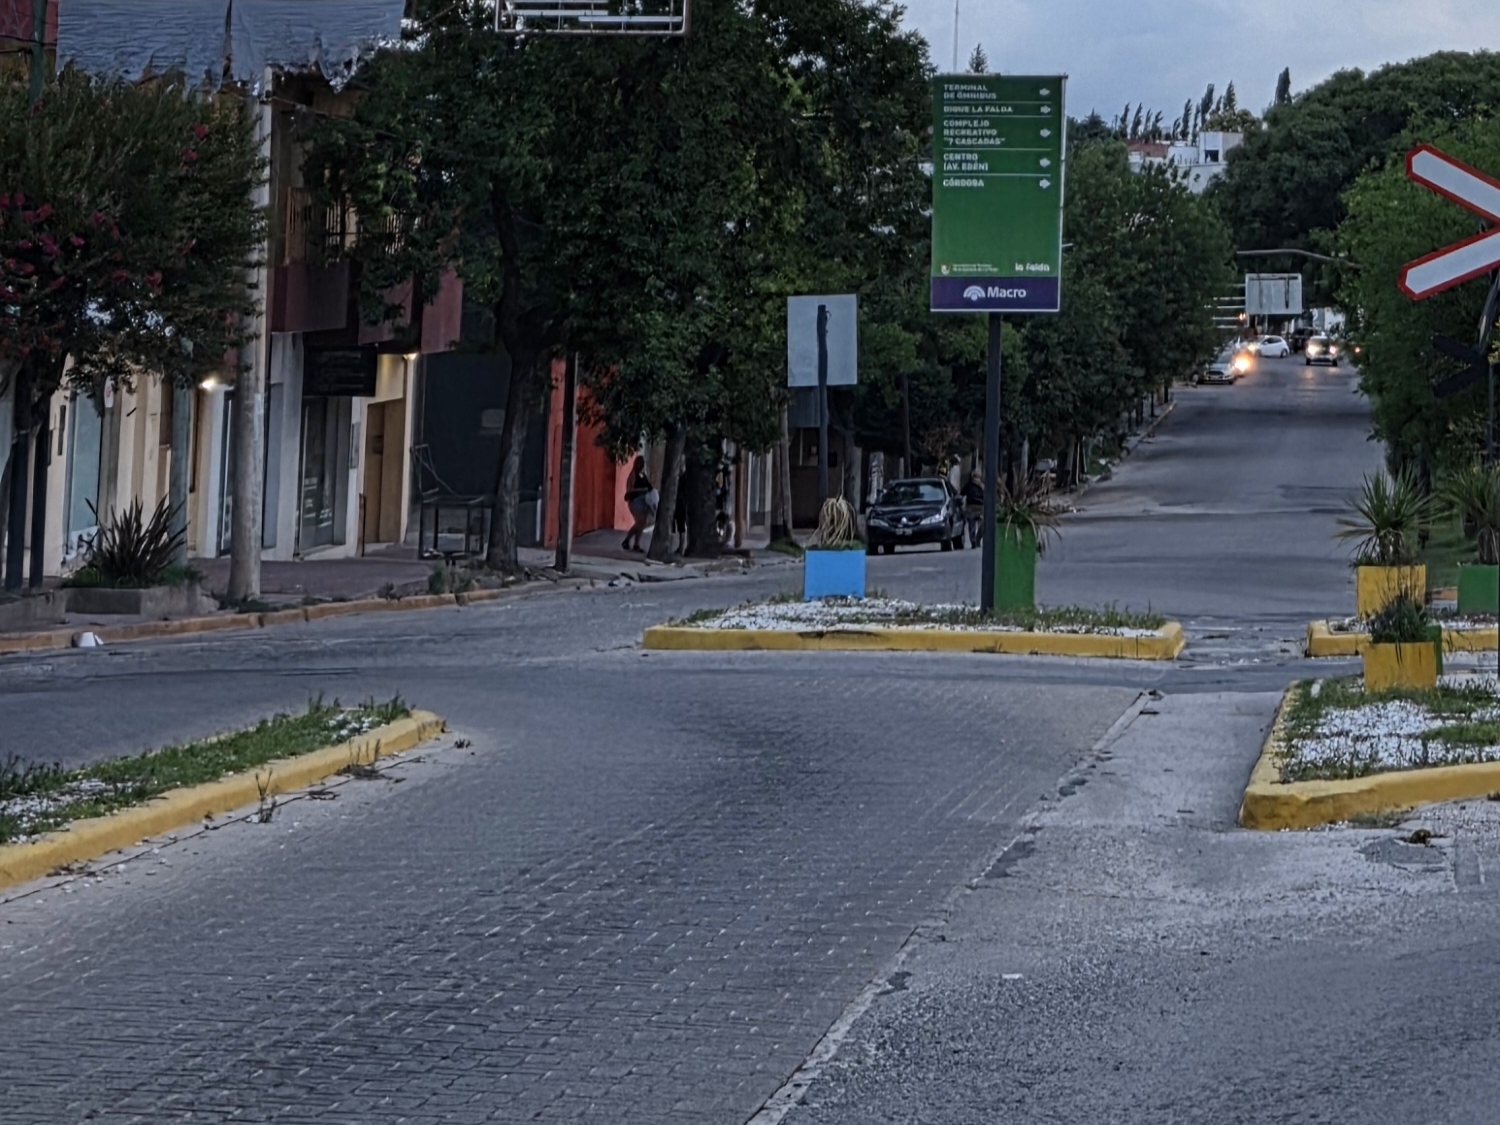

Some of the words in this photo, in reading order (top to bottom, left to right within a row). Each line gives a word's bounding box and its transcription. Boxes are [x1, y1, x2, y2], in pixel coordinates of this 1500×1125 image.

[944, 84, 988, 92] TERMINAL
[943, 92, 955, 100] DE
[971, 105, 983, 113] LA
[985, 105, 1013, 113] FALDA
[943, 119, 990, 127] COMPLEJO
[943, 128, 998, 136] RECREATIVO
[943, 153, 978, 161] CENTRO
[943, 177, 985, 187] CÓRDOBA
[987, 286, 1027, 298] Macro
